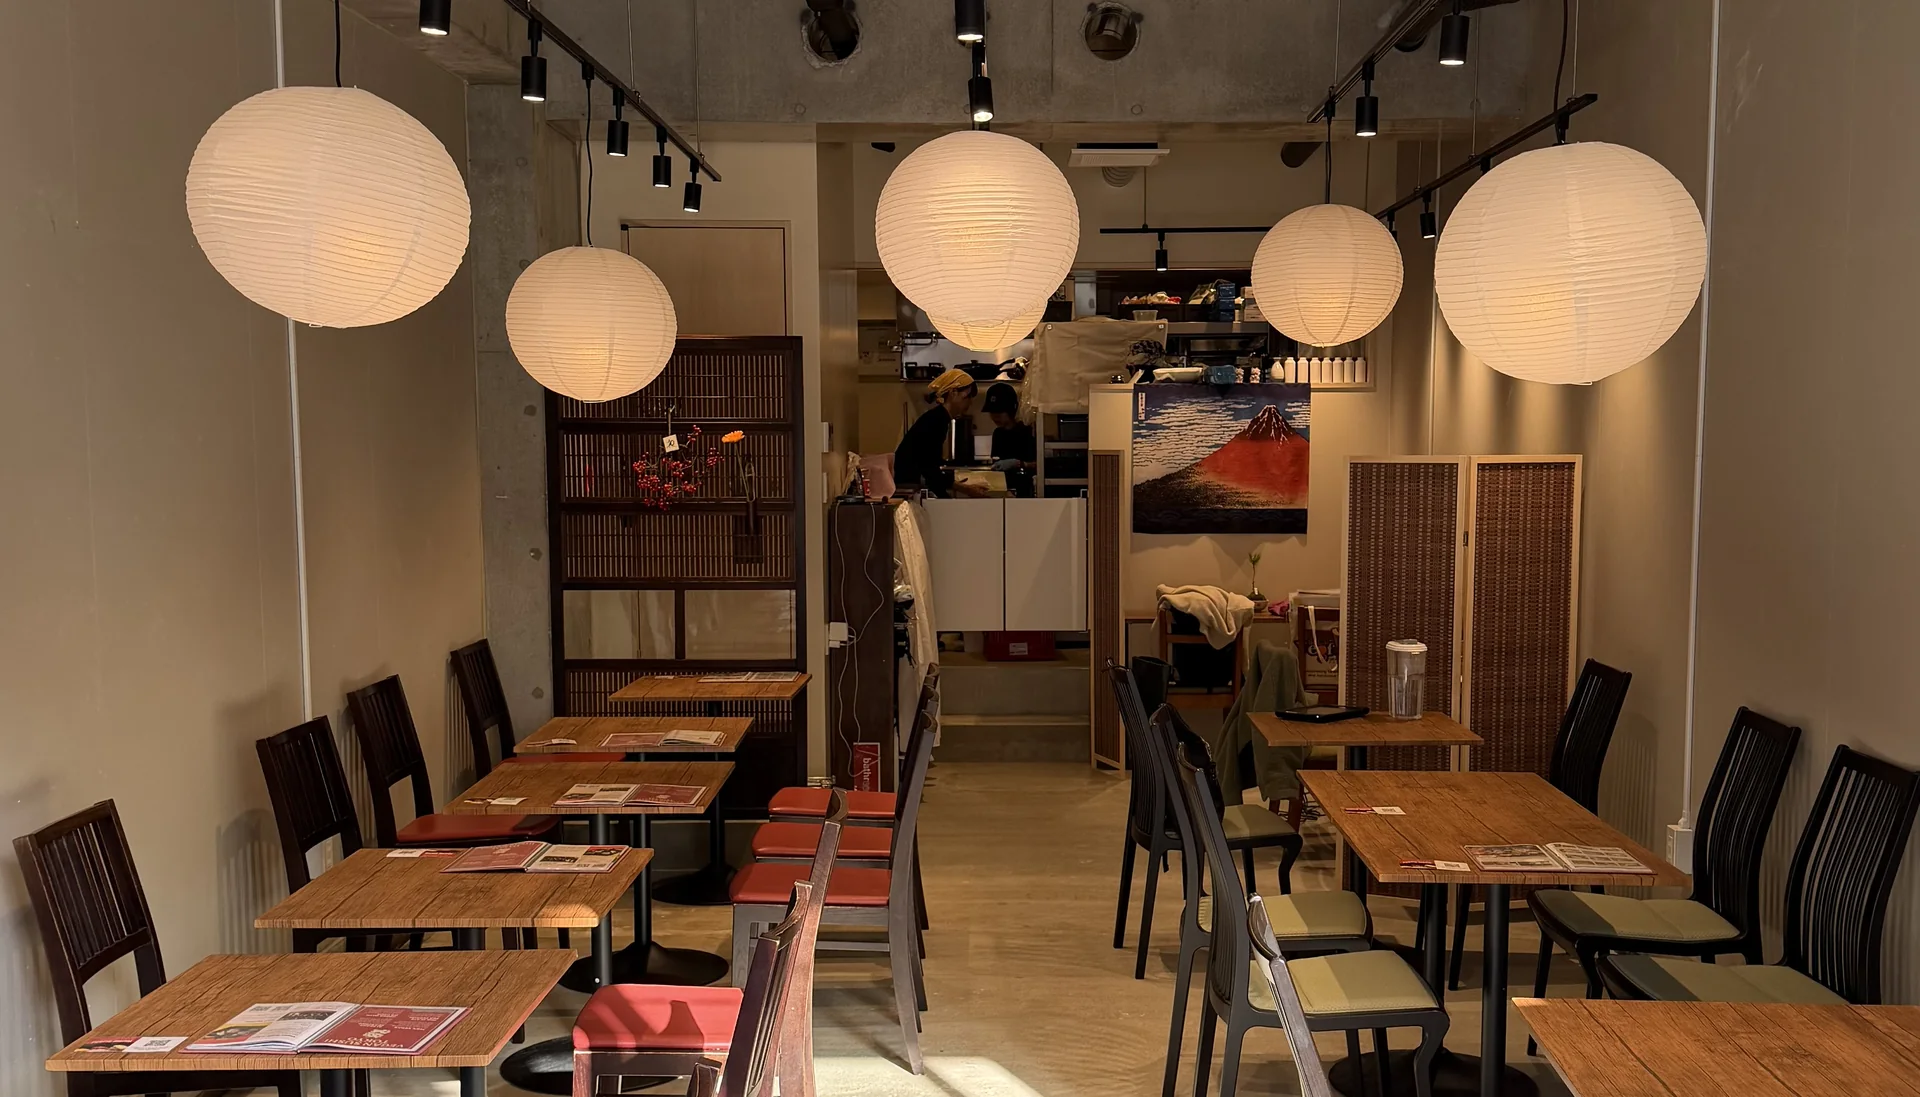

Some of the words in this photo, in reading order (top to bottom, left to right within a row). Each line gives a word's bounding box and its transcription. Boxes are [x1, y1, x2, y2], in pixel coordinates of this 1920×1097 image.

[863, 757, 871, 791] bathroo
[324, 1038, 362, 1046] SUSHI
[362, 1040, 404, 1048] VEGAN
